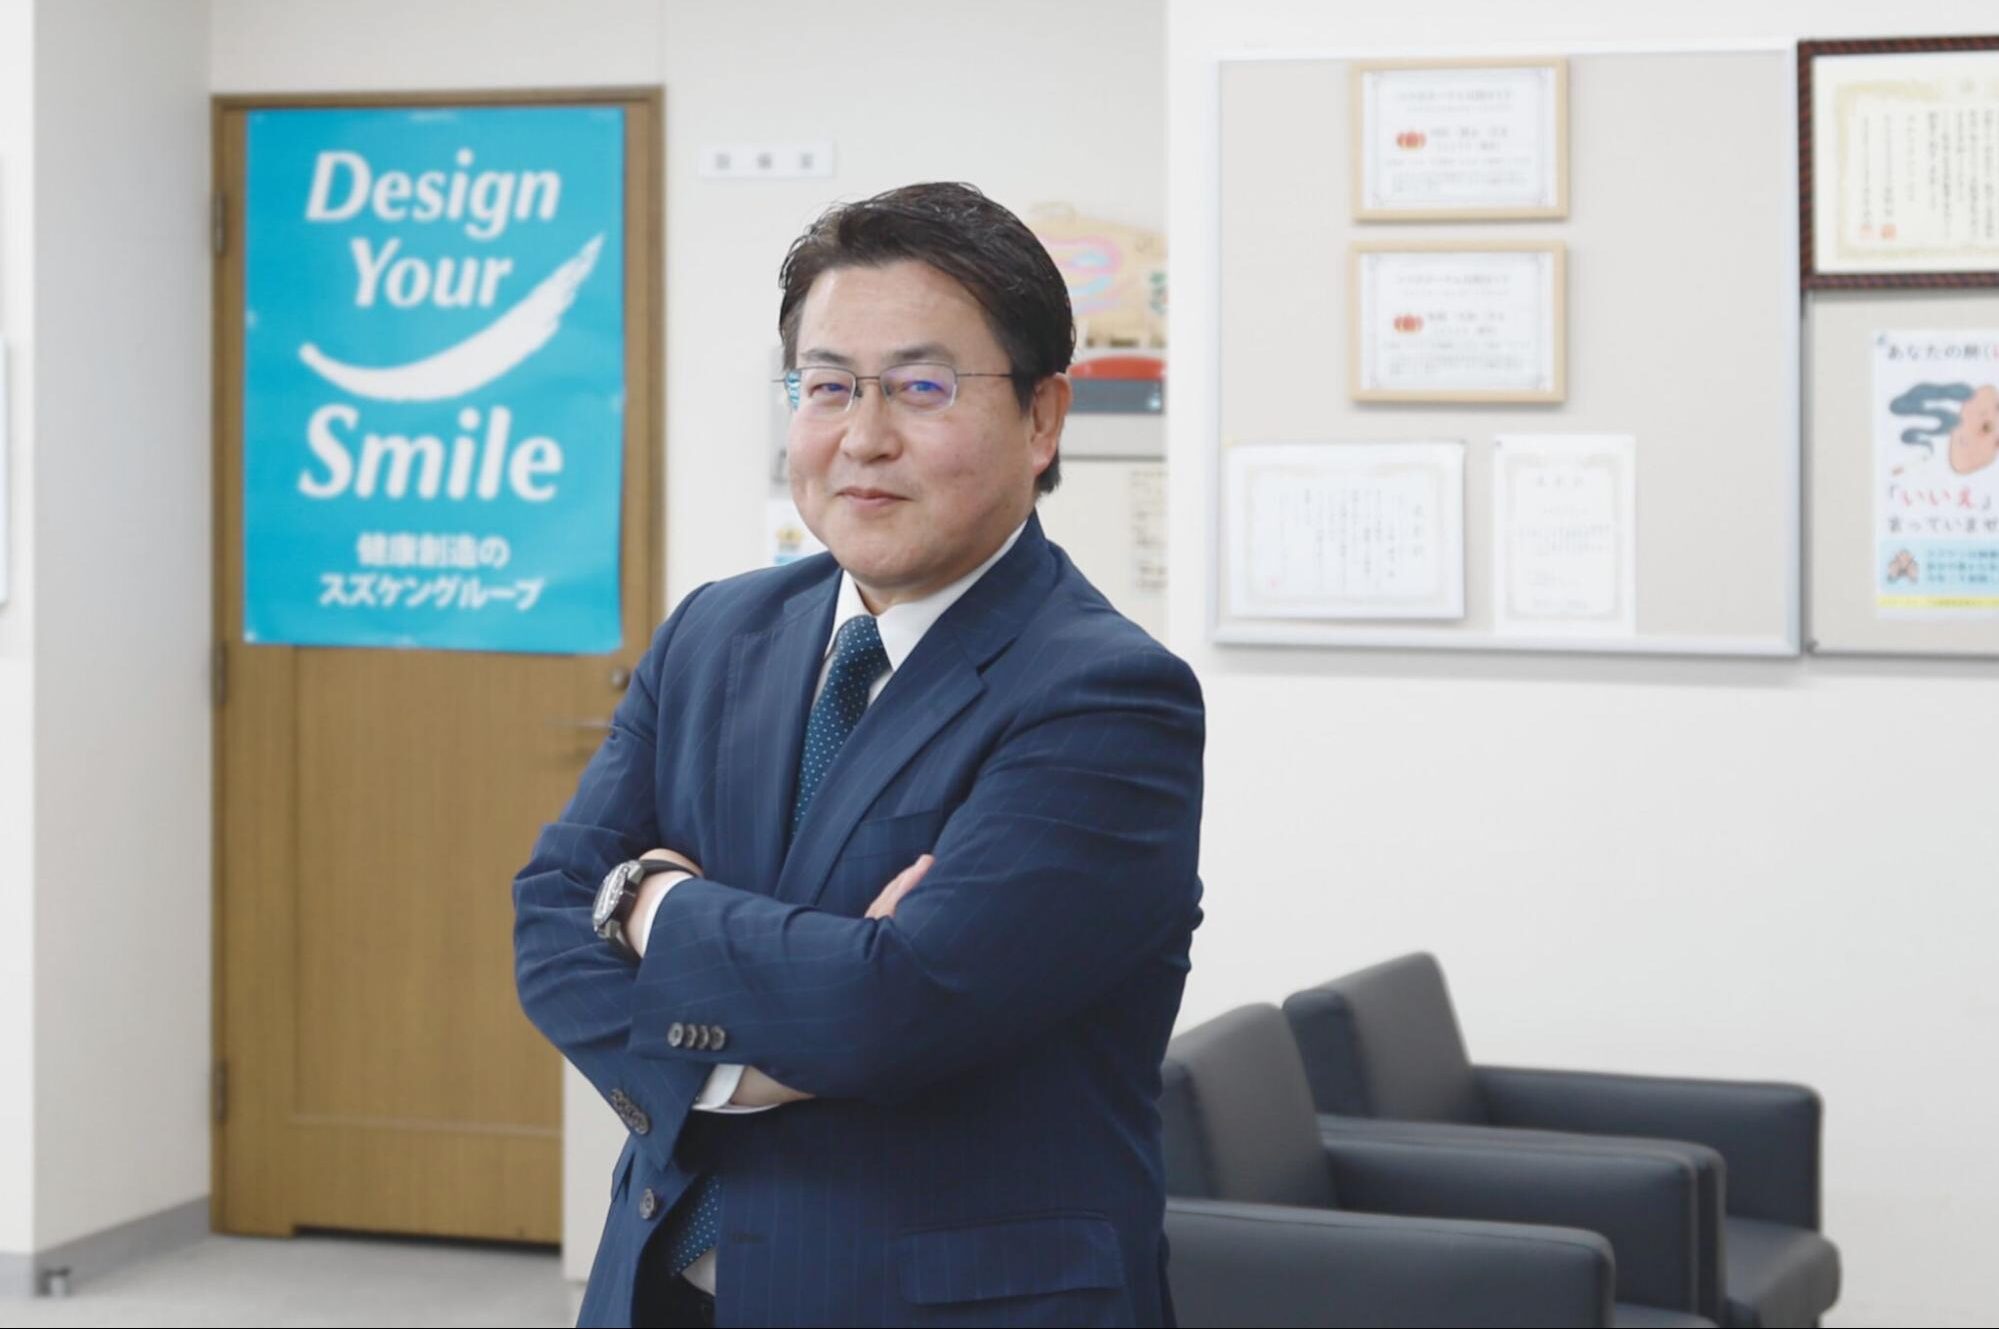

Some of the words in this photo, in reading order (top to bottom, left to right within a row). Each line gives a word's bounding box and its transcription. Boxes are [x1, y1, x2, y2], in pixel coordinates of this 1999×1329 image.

[304, 148, 561, 240] Design
[351, 236, 513, 308] Your
[298, 403, 564, 501] Smile
